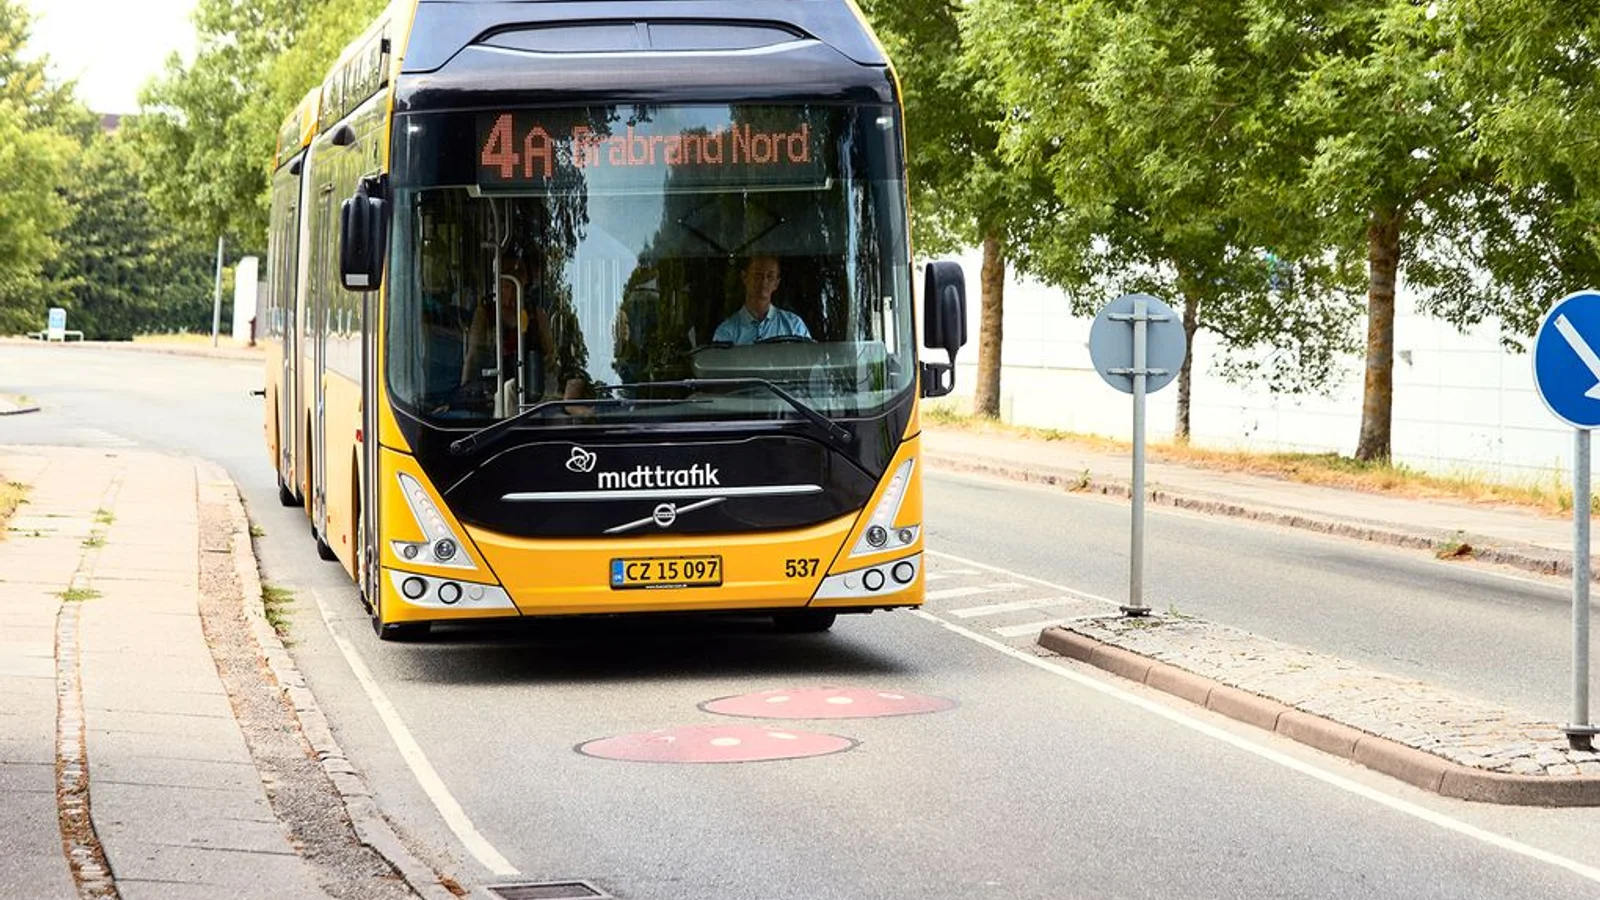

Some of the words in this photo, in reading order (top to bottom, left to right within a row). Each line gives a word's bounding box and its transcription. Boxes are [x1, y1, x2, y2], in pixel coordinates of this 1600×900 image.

[481, 112, 554, 179] 4A
[732, 122, 810, 163] Nord
[598, 463, 720, 488] midttrafik
[626, 561, 650, 580] CZ
[658, 562, 678, 580] 15
[684, 561, 717, 579] 097
[785, 558, 820, 577] 537
